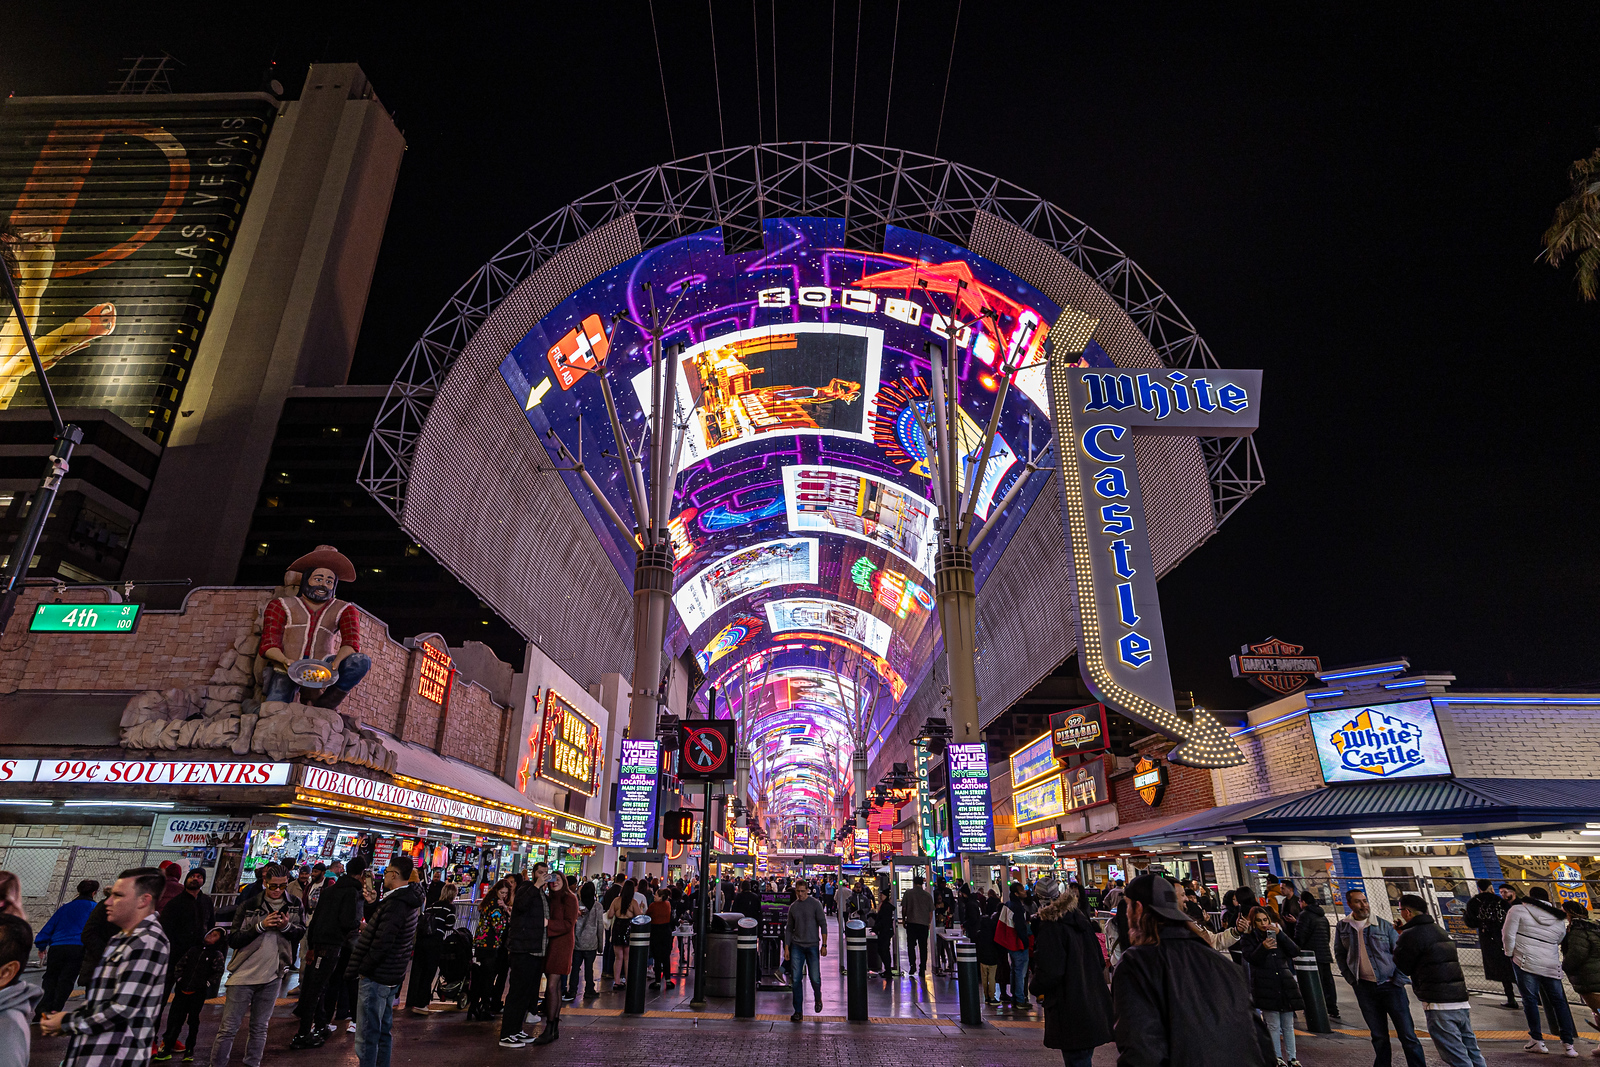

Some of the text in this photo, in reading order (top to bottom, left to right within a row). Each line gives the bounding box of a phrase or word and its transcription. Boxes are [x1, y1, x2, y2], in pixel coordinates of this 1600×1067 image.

[164, 118, 246, 278] LAS VEGAS
[561, 370, 573, 386] AID
[1081, 370, 1249, 420] White
[1081, 423, 1152, 669] Castle
[38, 606, 131, 628] N 4th St
[116, 620, 132, 629] 100
[1243, 658, 1318, 672] HARLEY-DAVIDSON
[563, 709, 587, 752] VIVA
[1056, 728, 1081, 741] PIZZA
[1081, 724, 1098, 737] BAR
[1341, 726, 1412, 750] White
[555, 739, 589, 782] VEGAS
[622, 749, 658, 758] YOUR
[950, 753, 986, 761] YOUR
[1342, 745, 1420, 767] Castle
[622, 757, 658, 767] LIFE
[951, 761, 987, 770] LIFE
[52, 761, 101, 783] 99¢
[104, 761, 275, 784] SOUVENIRS
[309, 767, 374, 798] TOBACCO
[465, 804, 504, 826] SOUVENIRS
[505, 813, 522, 830] BEER
[170, 820, 246, 832] COLDEST BEER
[565, 820, 577, 832] HATS
[579, 824, 595, 836] LIQUOR
[173, 833, 207, 844] IN TOWN
[1559, 889, 1588, 900] Open
